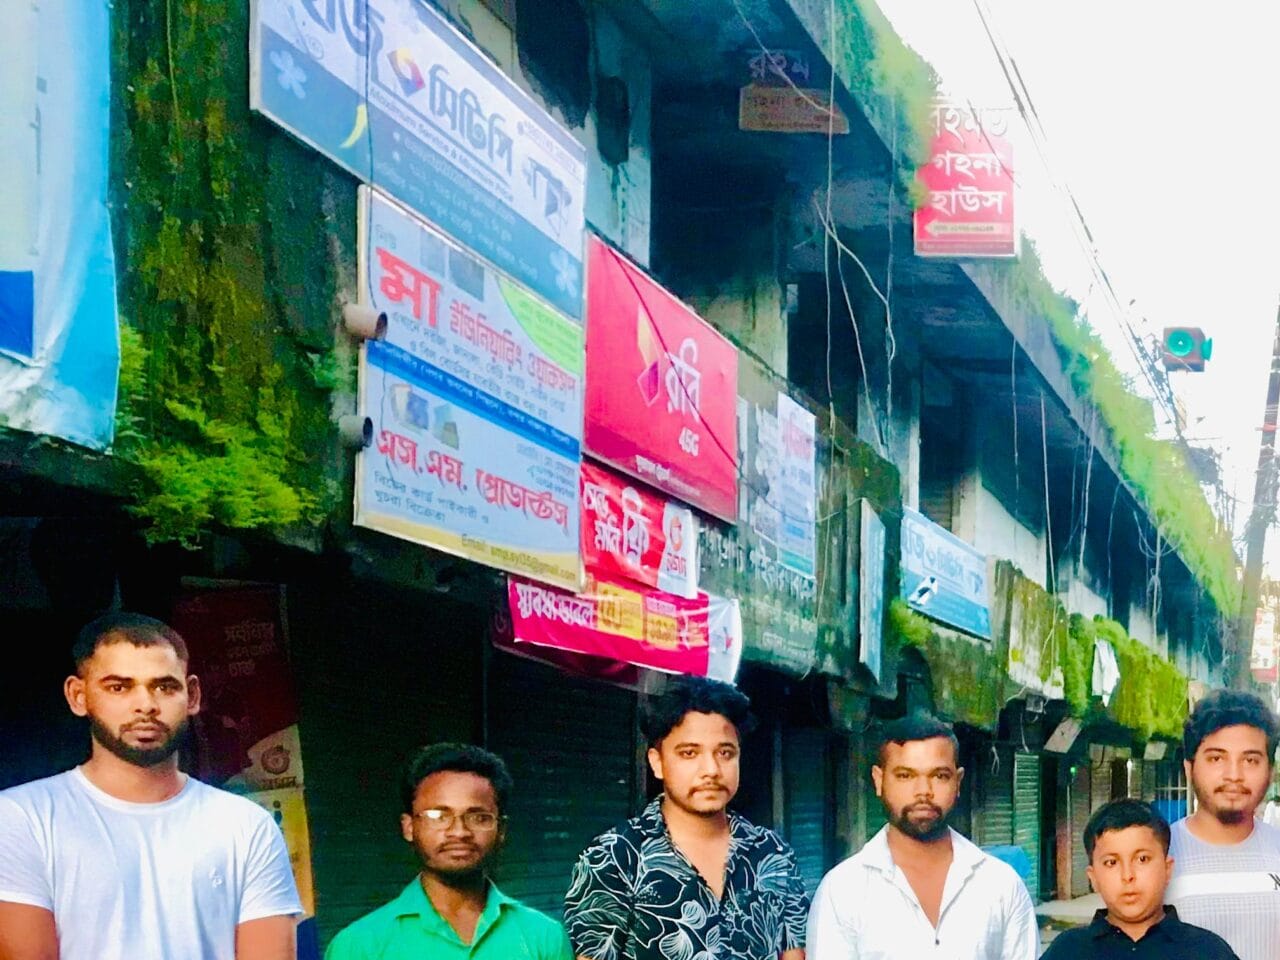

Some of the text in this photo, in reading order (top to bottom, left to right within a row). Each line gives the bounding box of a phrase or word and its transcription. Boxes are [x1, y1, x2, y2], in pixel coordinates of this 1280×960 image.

[933, 150, 1003, 179] গহনা
[928, 184, 1007, 217] হাউস
[375, 246, 441, 327] মা
[663, 338, 703, 422] রবি
